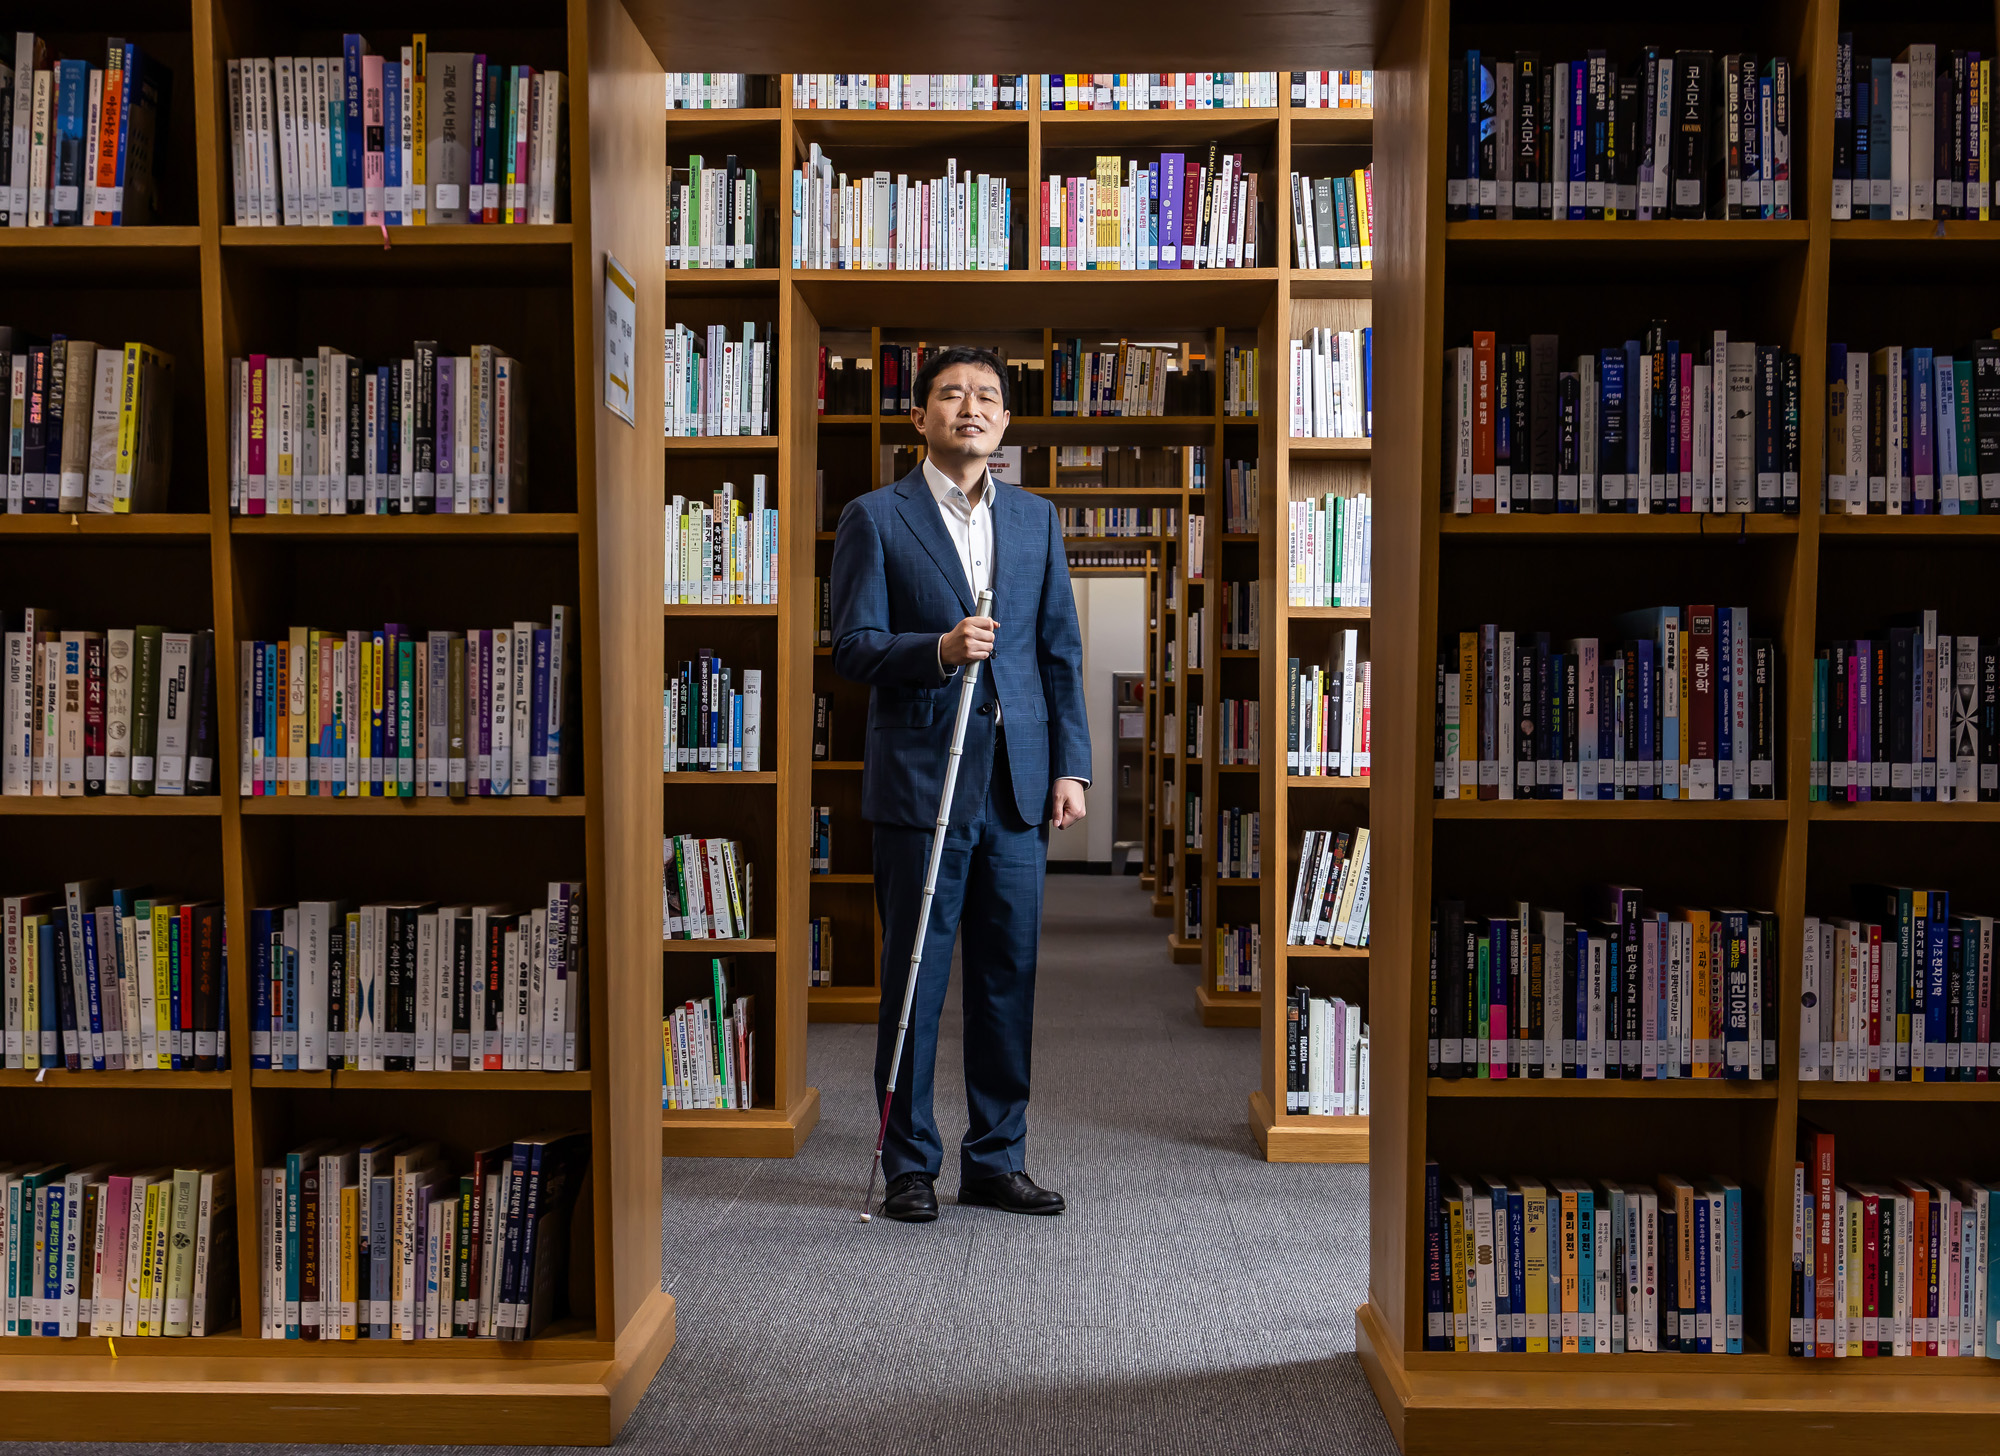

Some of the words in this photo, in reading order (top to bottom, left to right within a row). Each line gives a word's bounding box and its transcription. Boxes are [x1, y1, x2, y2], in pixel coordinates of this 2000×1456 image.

[1660, 68, 1670, 99] 코스모스
[1970, 61, 1979, 88] 상대성
[1596, 83, 1606, 110] 아쿠아
[1685, 66, 1700, 120] 코스모스
[1729, 73, 1738, 112] 스페이스
[1743, 61, 1755, 126] 우주탐사의
[104, 96, 118, 140] 아름다운
[348, 101, 358, 118] 수학
[1521, 105, 1535, 156] 코스모스
[1730, 112, 1738, 143] 오페라
[102, 141, 115, 159] 실험
[1744, 127, 1756, 166] 물리학
[1205, 145, 1216, 193] CHAMPAGNE
[1515, 378, 1525, 408] 경이로운
[1732, 376, 1750, 384] 우주를
[1682, 385, 1690, 417] 우주미션
[1785, 391, 1797, 420] 사적인
[1852, 392, 1863, 421] THREE
[251, 406, 264, 439] 수학N
[1515, 410, 1525, 428] 우주
[1565, 405, 1573, 442] 제네시스
[1682, 418, 1691, 442] 이야기
[1785, 424, 1797, 451] 은하수
[1851, 424, 1862, 463] QUARKS
[713, 525, 722, 573] 축산학개론
[1695, 646, 1710, 694] 측량학
[1756, 648, 1766, 667] 1초의
[1985, 655, 1995, 682] 관계의
[1756, 667, 1766, 684] 탄생
[88, 681, 100, 705] 지식
[1985, 684, 1995, 703] 과학
[1552, 708, 1560, 733] 이야기
[1358, 876, 1369, 901] BASICS
[559, 899, 568, 922] How
[558, 922, 568, 933] to
[557, 933, 568, 960] Prove
[1532, 943, 1542, 955] THE
[1731, 939, 1740, 969] 재미있는
[1916, 919, 1925, 966] 전자기학의
[556, 960, 567, 968] It
[1532, 955, 1542, 978] WORLD
[1626, 944, 1638, 980] 물리학의
[1932, 938, 1943, 996] 기초전자기학
[1532, 978, 1542, 998] ITSELF
[1627, 983, 1636, 1004] 세계
[1731, 971, 1746, 998] 물리
[1966, 968, 1976, 1007] 양자물리학
[1731, 1000, 1746, 1028] 여행
[1966, 1008, 1974, 1023] 강의
[1299, 1036, 1308, 1062] FOCACCIA
[1821, 1178, 1831, 1210] 슬기로운
[50, 1200, 61, 1220] 수학,
[275, 1188, 283, 1228] 프로그래머를
[1565, 1212, 1575, 1230] 물리
[1581, 1212, 1590, 1230] 물리
[50, 1220, 60, 1246] 생각의
[275, 1230, 282, 1243] 위한
[373, 1222, 387, 1256] 미적분
[1453, 1220, 1461, 1234] 세계
[1821, 1212, 1831, 1245] 화학생활
[49, 1246, 59, 1264] 기술
[1454, 1237, 1462, 1260] 물리학
[1566, 1233, 1575, 1251] 열전
[1582, 1233, 1590, 1252] 열전
[1867, 1241, 1875, 1251] 17
[1455, 1261, 1463, 1283] 필독서
[1631, 1265, 1637, 1276] 물리
[1647, 1266, 1653, 1275] 물리
[1456, 1283, 1464, 1294] 30
